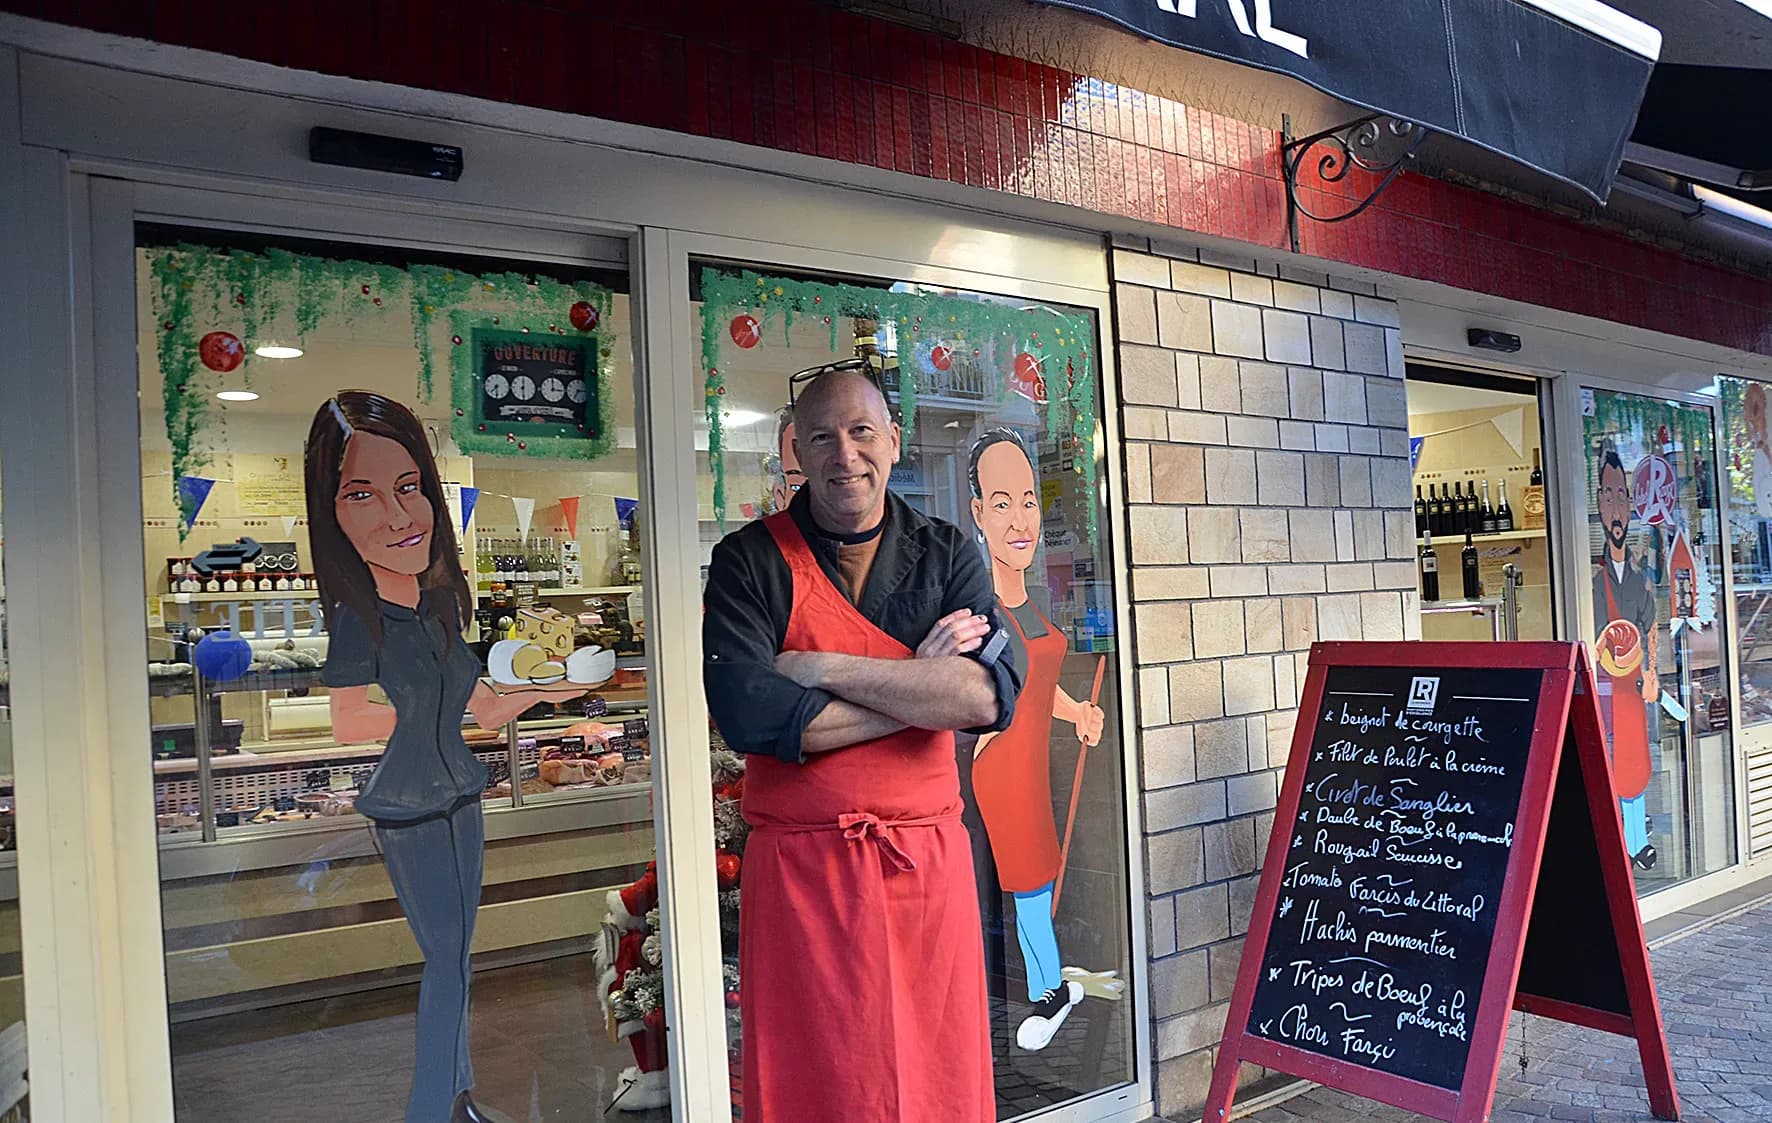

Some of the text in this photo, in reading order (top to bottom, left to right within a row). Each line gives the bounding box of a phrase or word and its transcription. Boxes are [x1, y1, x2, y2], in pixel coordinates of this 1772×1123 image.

[1394, 710, 1409, 729] de
[1412, 715, 1490, 744] courgette
[1328, 740, 1364, 762] Filet
[1363, 749, 1379, 765] de
[1384, 745, 1431, 767] Poulet
[1430, 757, 1441, 770] à
[1445, 750, 1458, 772] la
[1316, 806, 1360, 826] Daube
[1364, 815, 1384, 831] de
[1363, 785, 1385, 807] de
[1389, 786, 1475, 819] Sanglier
[1314, 828, 1380, 863] Rougail
[1349, 876, 1401, 904] Farcis
[1403, 890, 1420, 907] du
[1421, 891, 1485, 922] Littoral
[1299, 899, 1457, 960] Hachis parmentier
[1290, 960, 1344, 996] Tripes
[1351, 970, 1373, 999] de
[1437, 998, 1447, 1017] à
[1450, 989, 1466, 1024] la
